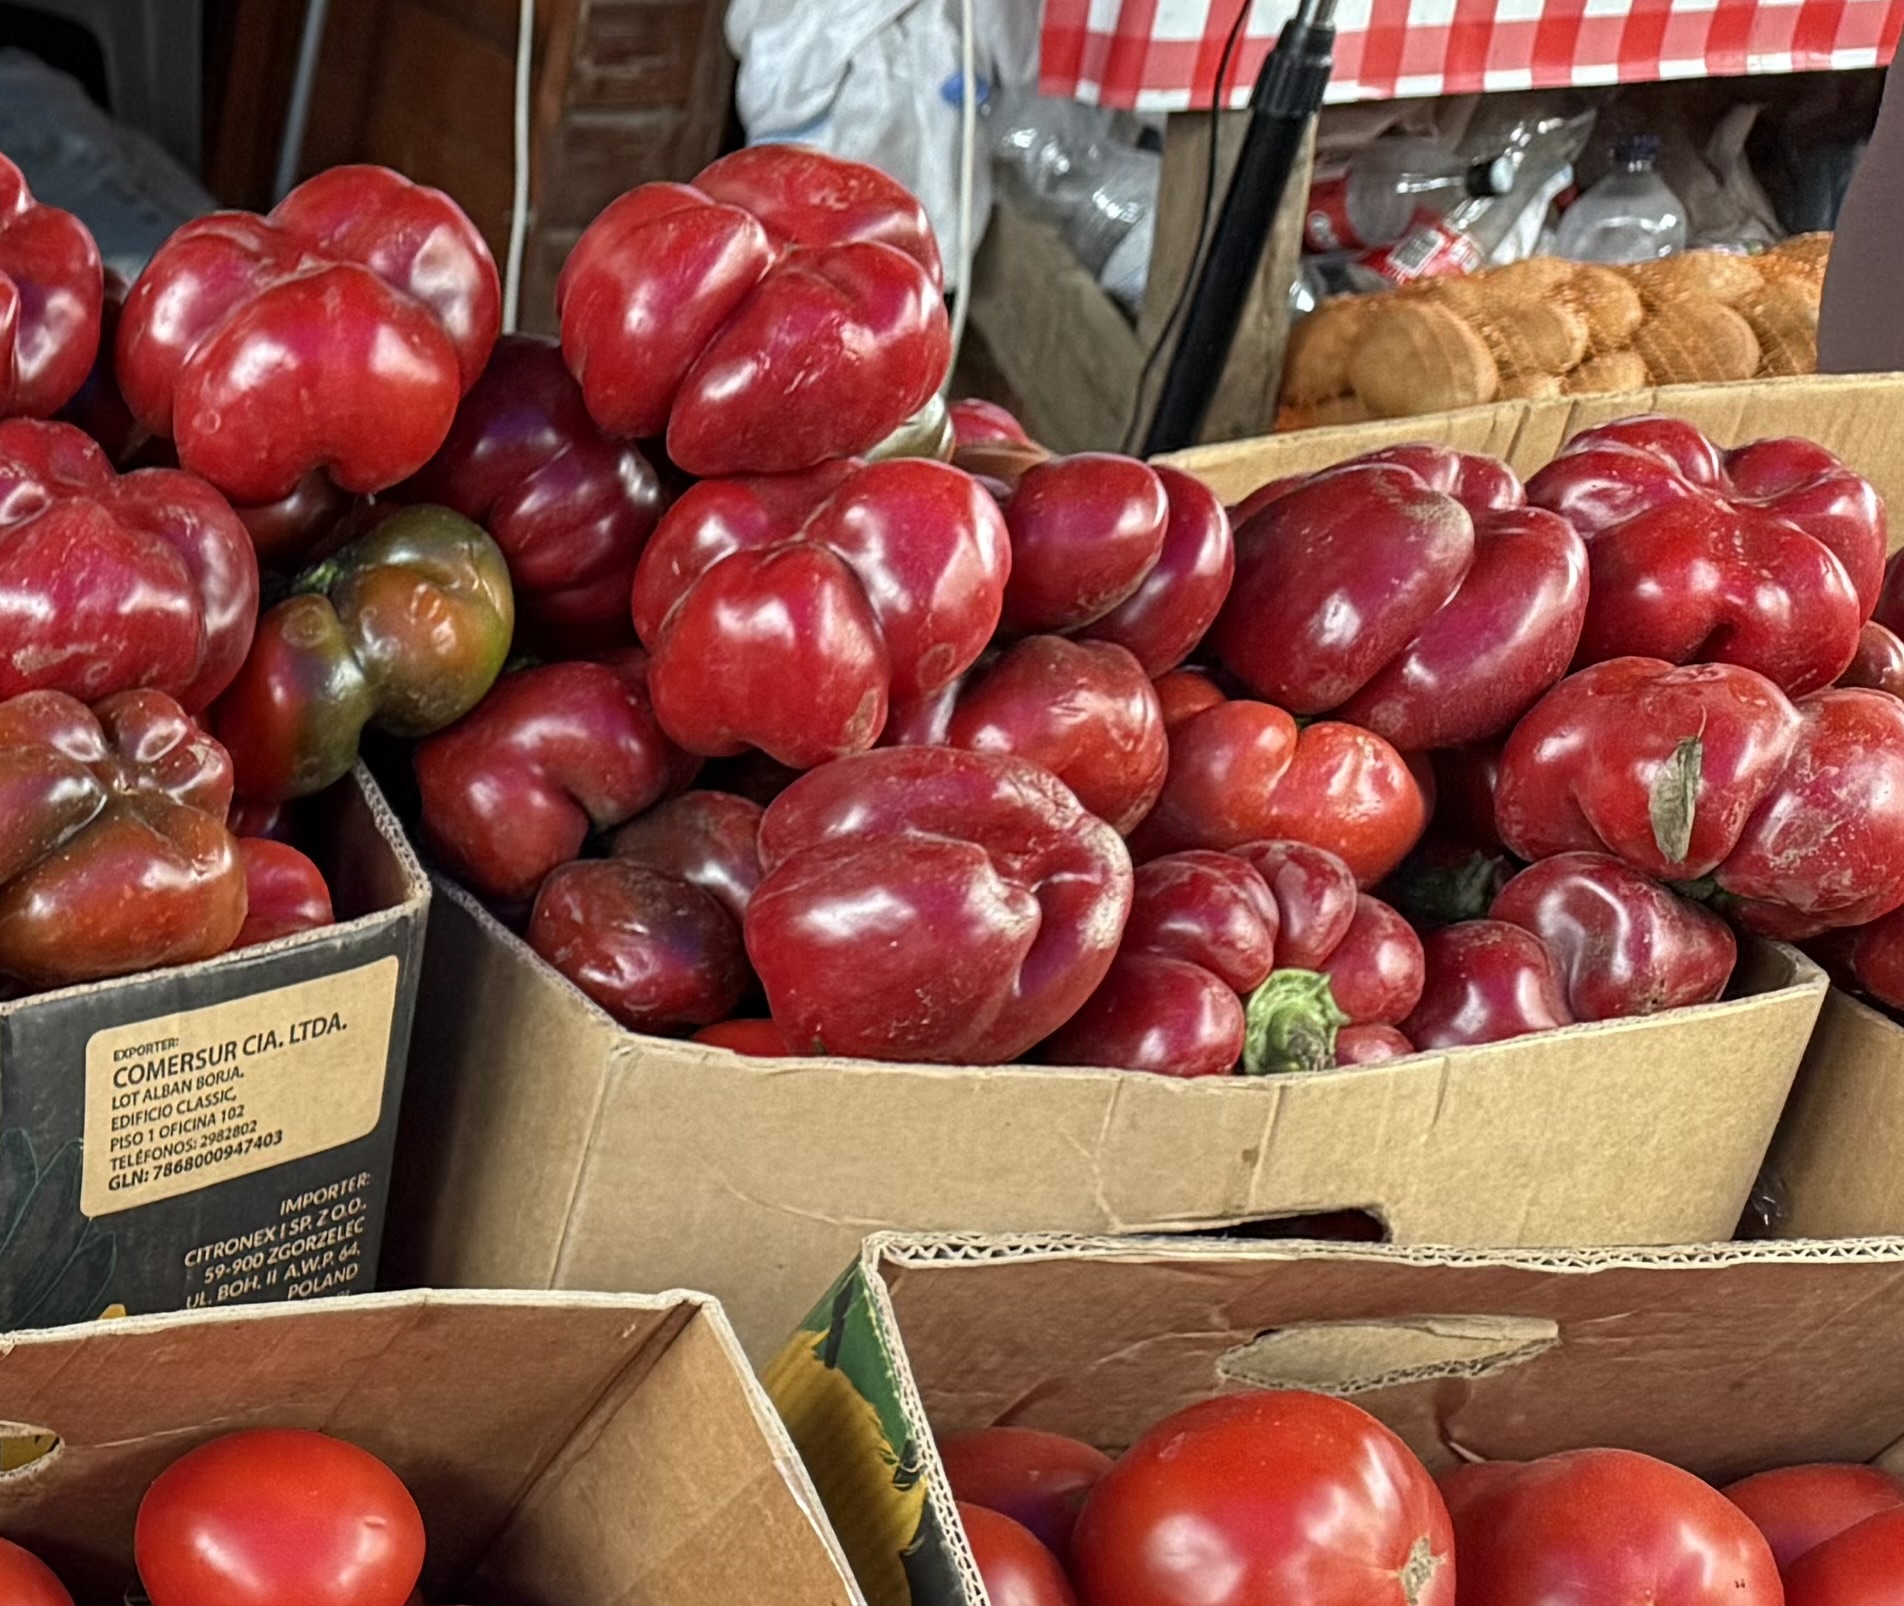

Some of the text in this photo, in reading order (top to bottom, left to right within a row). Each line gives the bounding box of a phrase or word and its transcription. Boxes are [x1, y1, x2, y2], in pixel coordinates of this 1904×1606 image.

[113, 1037, 179, 1062] EXPORTER:
[113, 1012, 347, 1088] COMERSUR CIA. LTDA.
[111, 1090, 140, 1110] LOT
[142, 1079, 192, 1104] ALBAN
[110, 1104, 245, 1152] PISO 1 OFICINA 102
[111, 1103, 173, 1132] EDIFICIO
[108, 1129, 283, 1191] GLN: 7868000947403
[280, 1172, 370, 1216] IMPORTER:
[184, 1225, 276, 1268] CITRONEX
[289, 1215, 312, 1236] SP.
[204, 1215, 366, 1284] 59-900 ZGORZELEC
[217, 1274, 261, 1302] BOH.
[287, 1263, 359, 1300] POLAND
